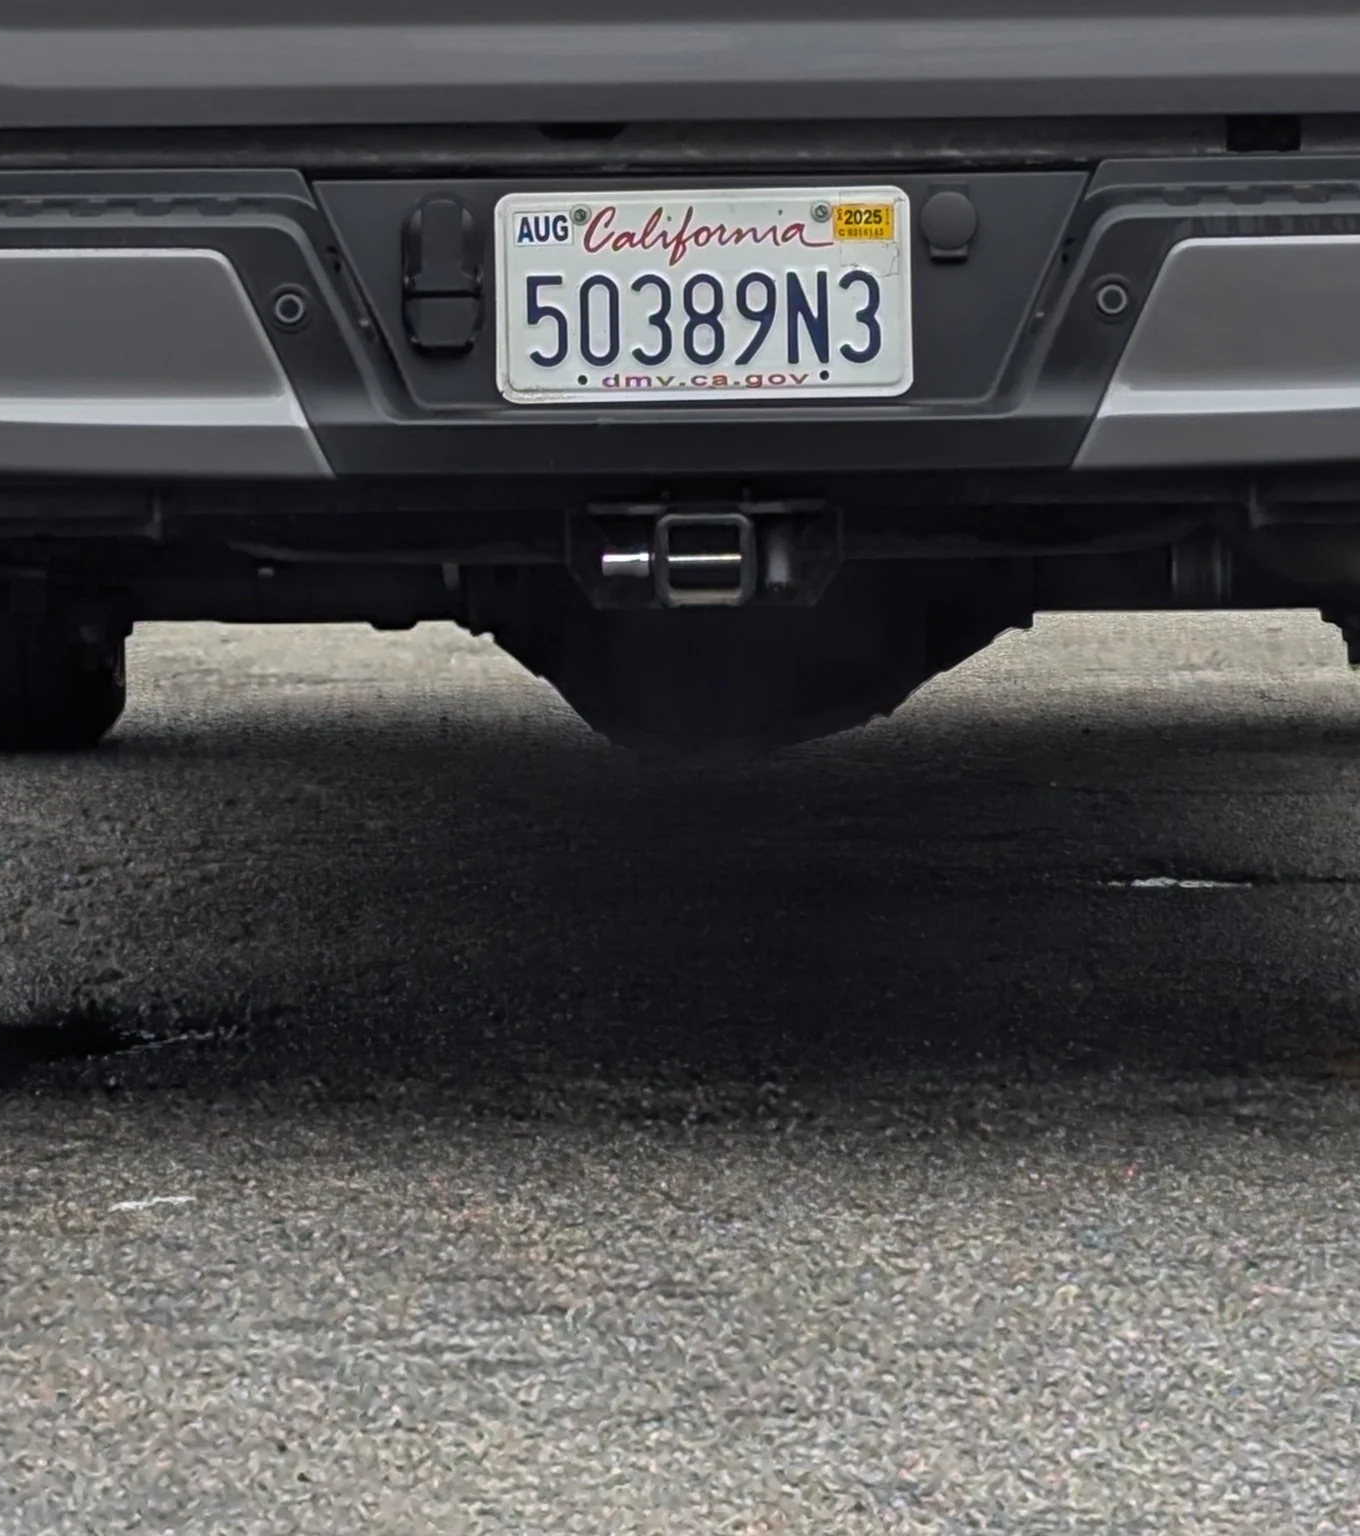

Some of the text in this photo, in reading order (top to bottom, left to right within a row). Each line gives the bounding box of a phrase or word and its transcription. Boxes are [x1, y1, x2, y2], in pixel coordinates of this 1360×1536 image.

[843, 208, 883, 225] 2025
[517, 215, 569, 244] AUG
[583, 206, 834, 266] California
[526, 270, 881, 366] 50389N3
[602, 373, 809, 389] dmv.ca.gov
